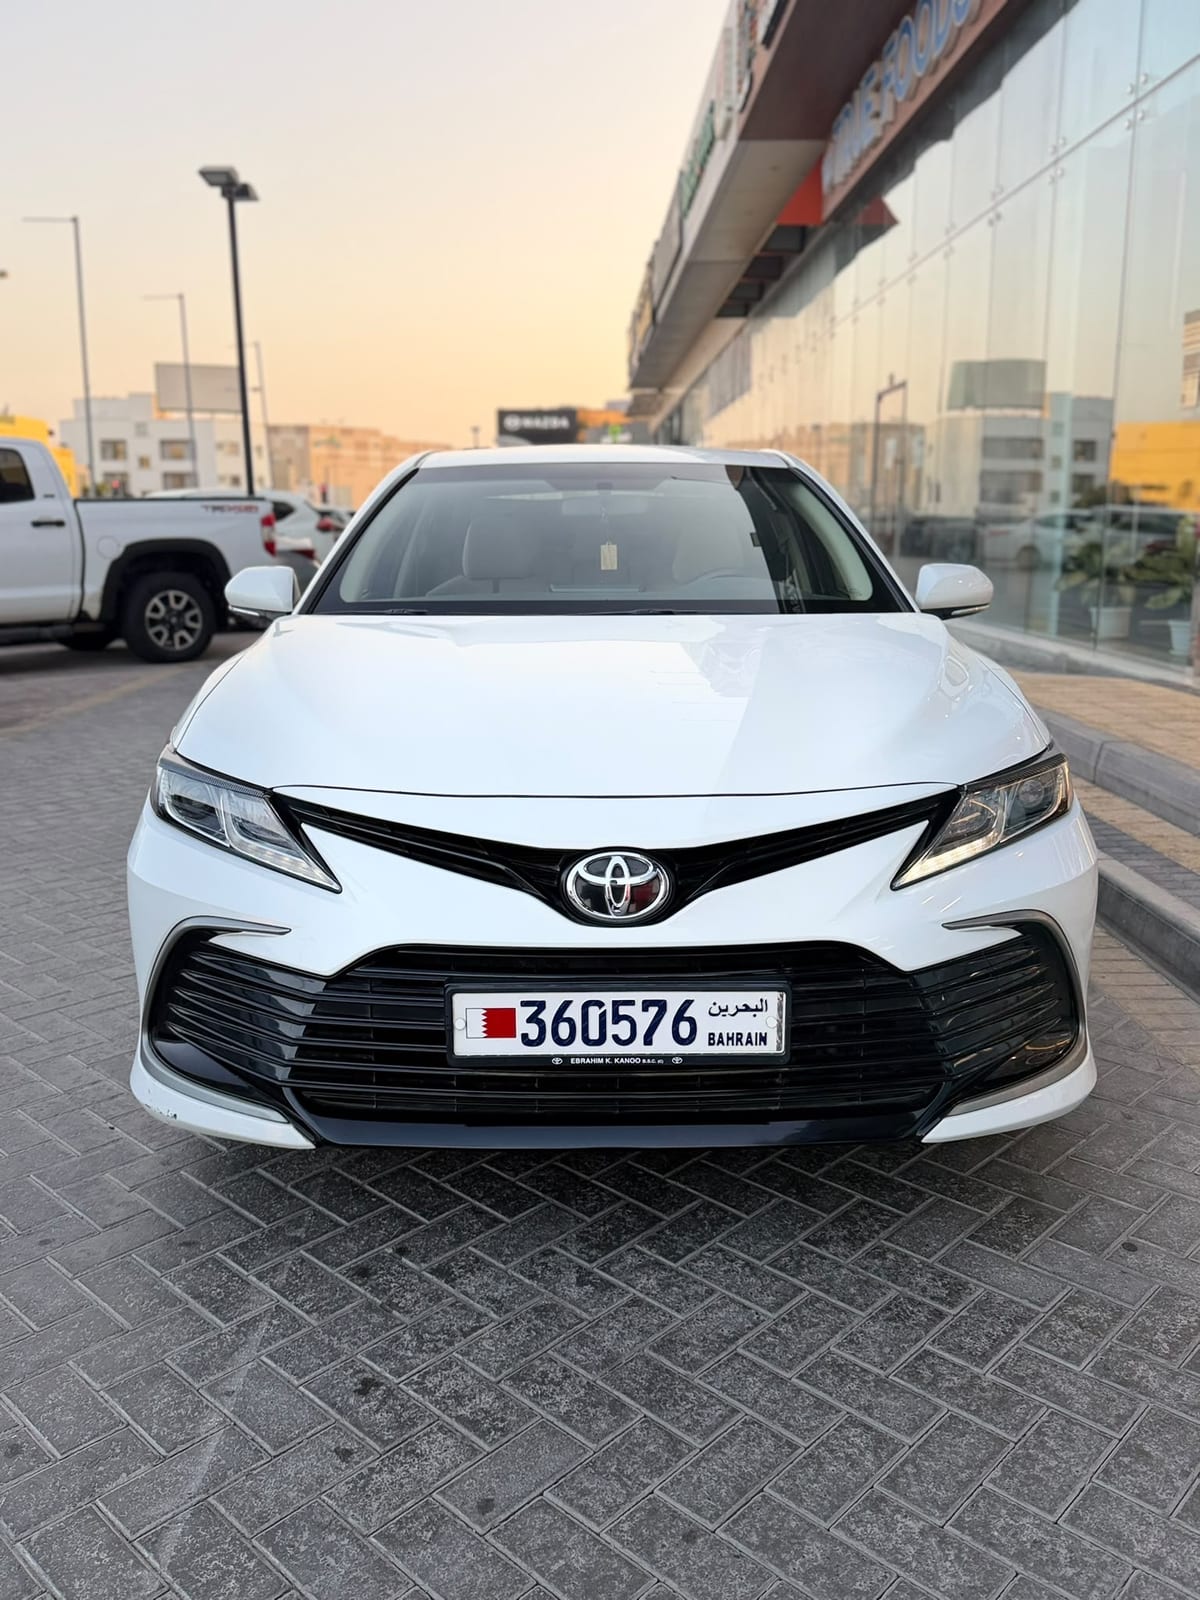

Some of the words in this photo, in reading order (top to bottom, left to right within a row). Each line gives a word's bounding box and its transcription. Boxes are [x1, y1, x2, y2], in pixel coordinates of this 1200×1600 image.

[708, 998, 768, 1017] البحرين
[520, 999, 697, 1047] 360576
[708, 1032, 768, 1046] BAHRAIN
[570, 1057, 604, 1065] EBRAHIM
[605, 1057, 613, 1065] K.
[614, 1057, 641, 1065] KANOO
